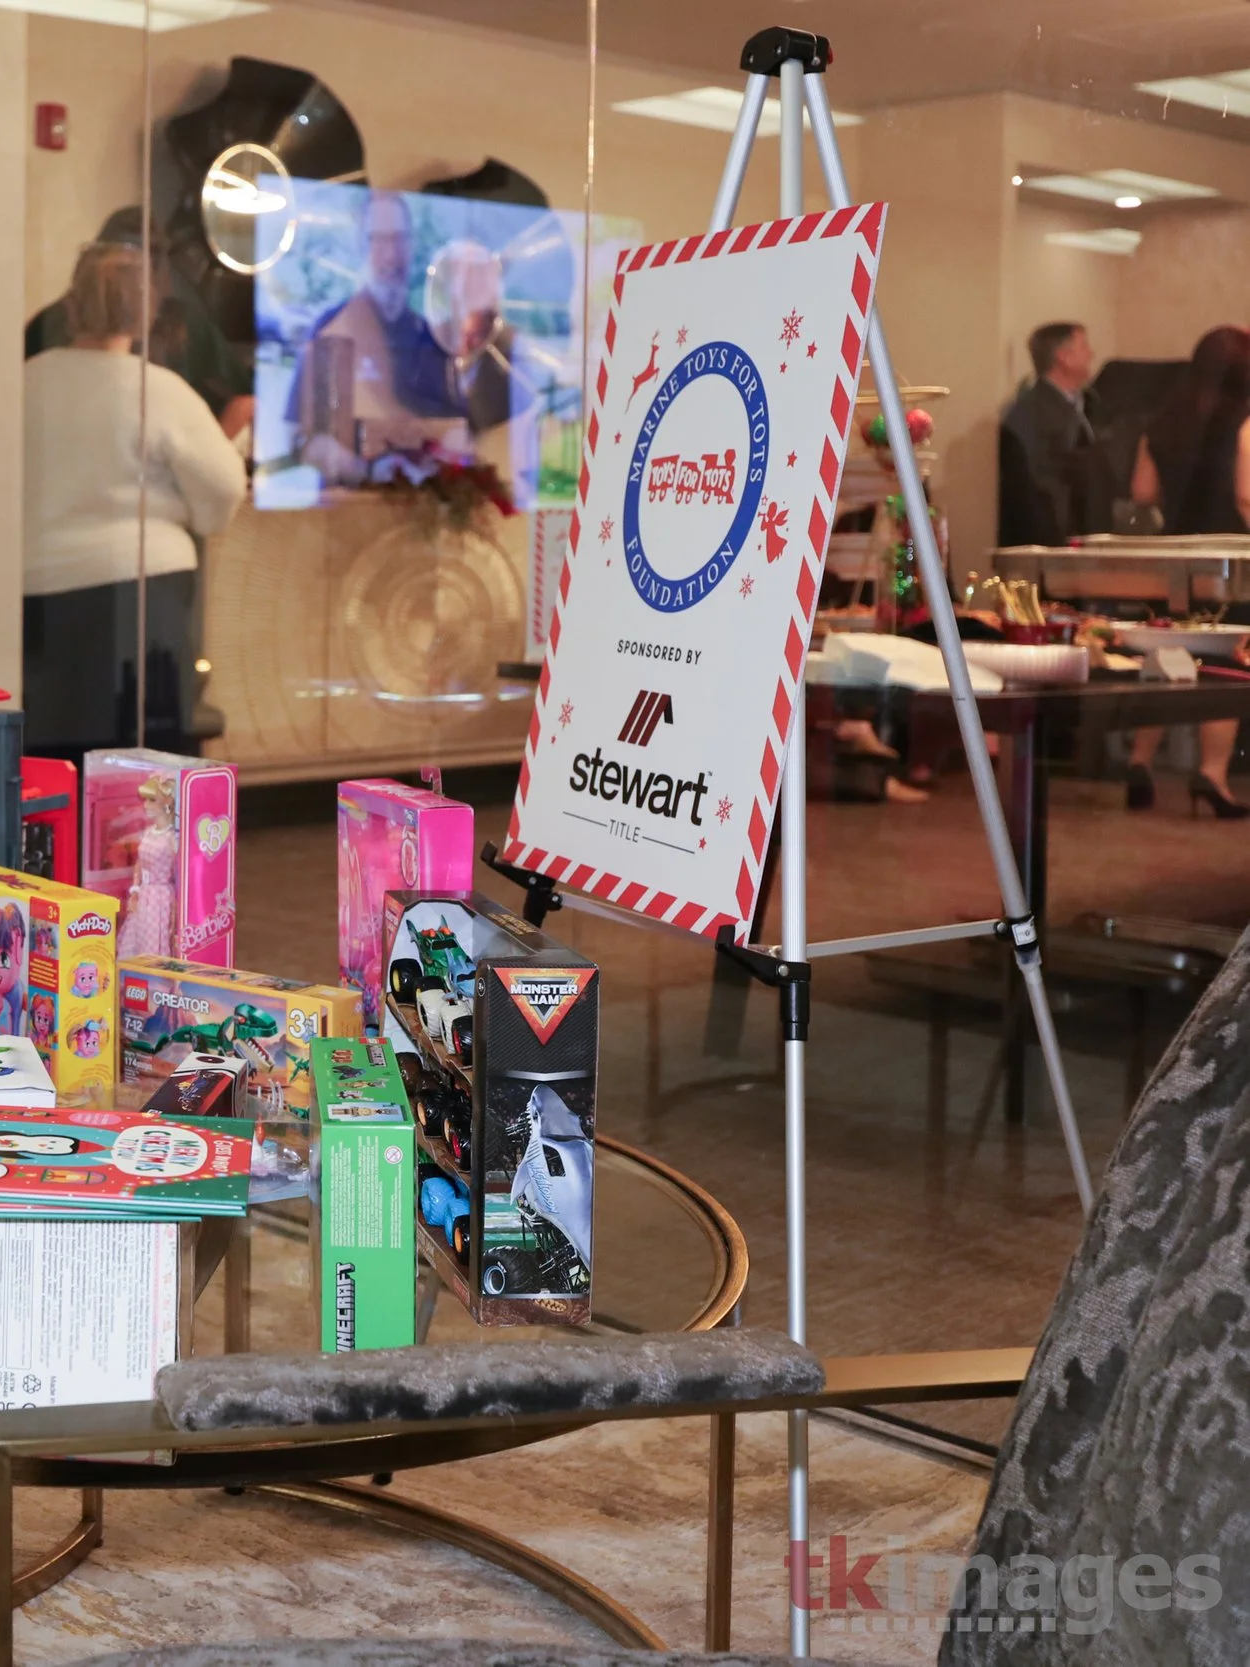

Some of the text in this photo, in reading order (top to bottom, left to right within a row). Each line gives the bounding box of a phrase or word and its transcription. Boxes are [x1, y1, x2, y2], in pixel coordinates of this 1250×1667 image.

[630, 348, 767, 483] MARINE TOYS FOR TOTS
[652, 458, 732, 492] TOYS FOR TOTS
[627, 536, 735, 607] FOUNDATION
[617, 639, 702, 665] SPONSORED BY
[569, 747, 708, 826] stewart
[607, 819, 641, 843] TITLE
[48, 905, 58, 918] 3+
[181, 911, 231, 951] Barbie
[126, 986, 146, 1000] LEGO
[153, 992, 209, 1013] CREATOR
[510, 984, 578, 995] MONSTER
[529, 995, 559, 1005] JAM
[125, 1018, 143, 1032] 7-12
[135, 1130, 171, 1172] CHRISTMAS
[169, 1139, 200, 1167] MERRY
[336, 1262, 355, 1353] INECRAFT
